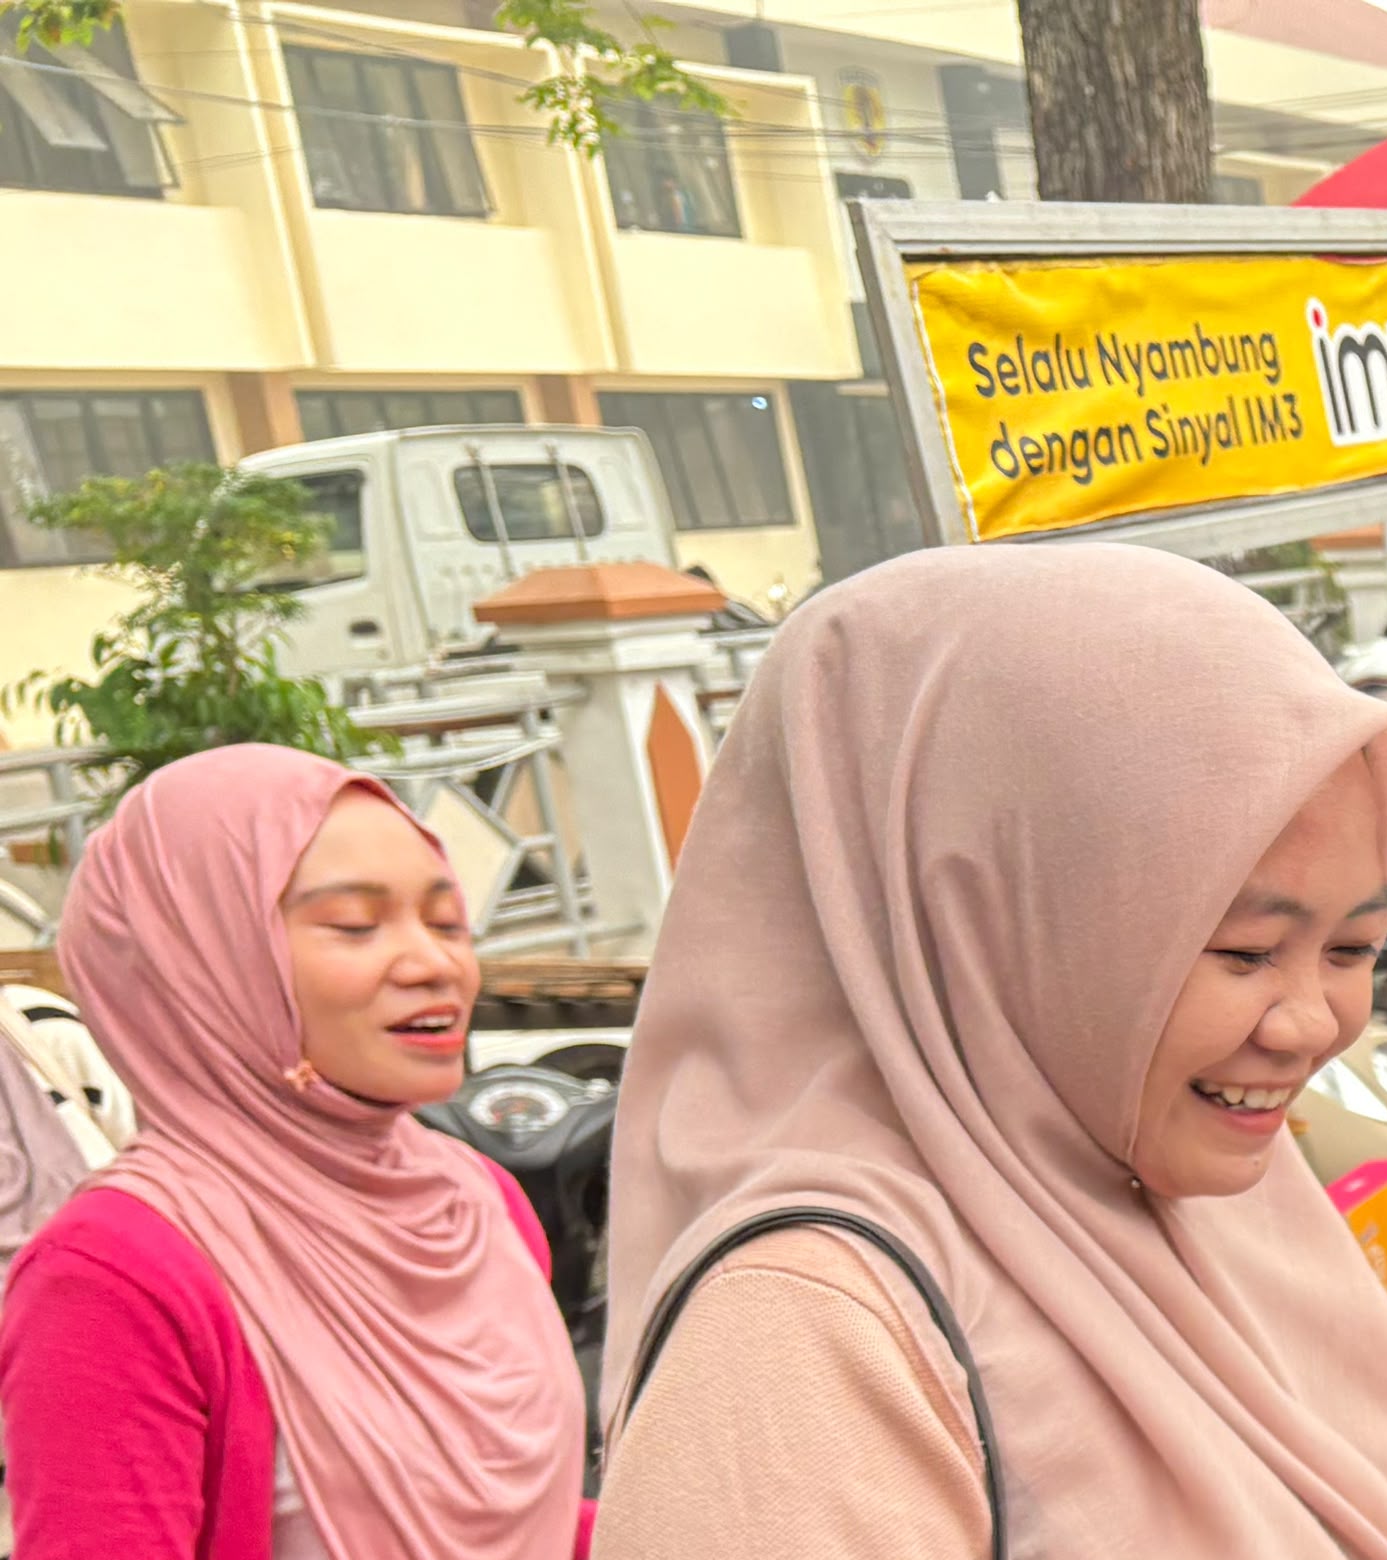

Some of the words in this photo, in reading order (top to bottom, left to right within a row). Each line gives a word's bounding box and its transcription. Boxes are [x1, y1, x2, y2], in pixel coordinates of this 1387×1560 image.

[968, 333, 1092, 398] Selalu
[1099, 321, 1281, 397] Nyambung
[990, 420, 1144, 486] dengan
[1146, 400, 1243, 466] Sinyal
[1246, 392, 1304, 445] IM3
